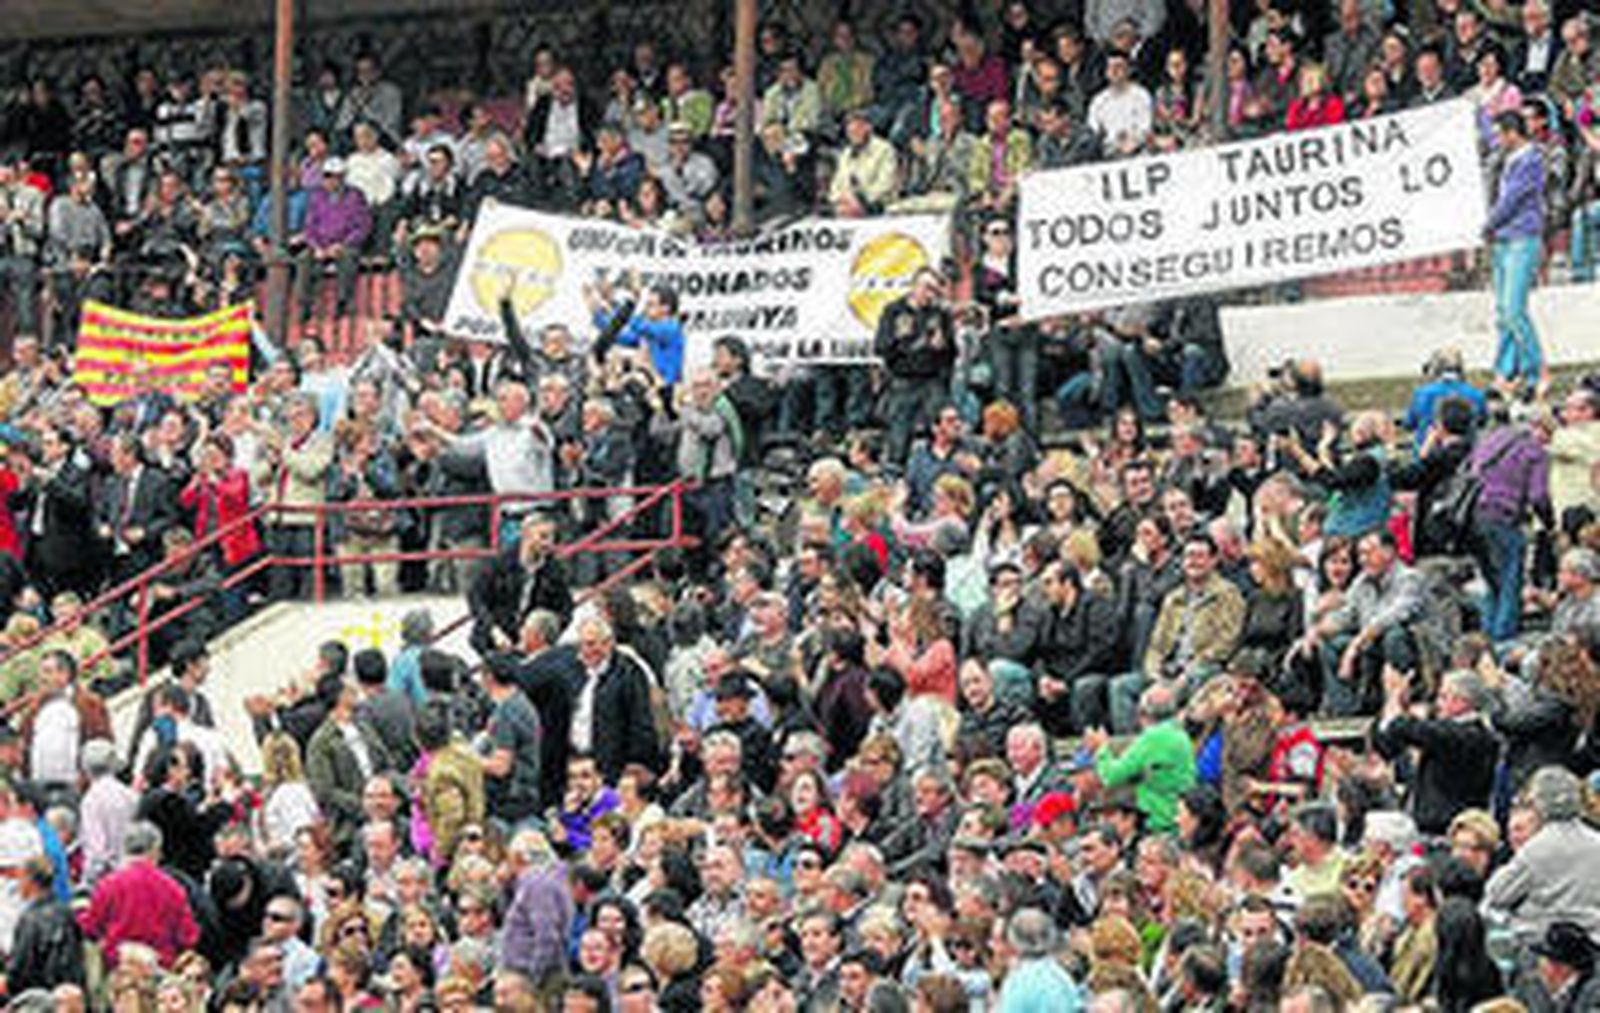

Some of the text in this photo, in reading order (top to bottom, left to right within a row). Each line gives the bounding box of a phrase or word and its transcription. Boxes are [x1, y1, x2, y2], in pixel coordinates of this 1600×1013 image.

[1101, 118, 1410, 200] ILP TAURINA
[1026, 153, 1453, 249] TODOS JUNTOS LO
[1038, 216, 1405, 297] CONSEGUIREMOS
